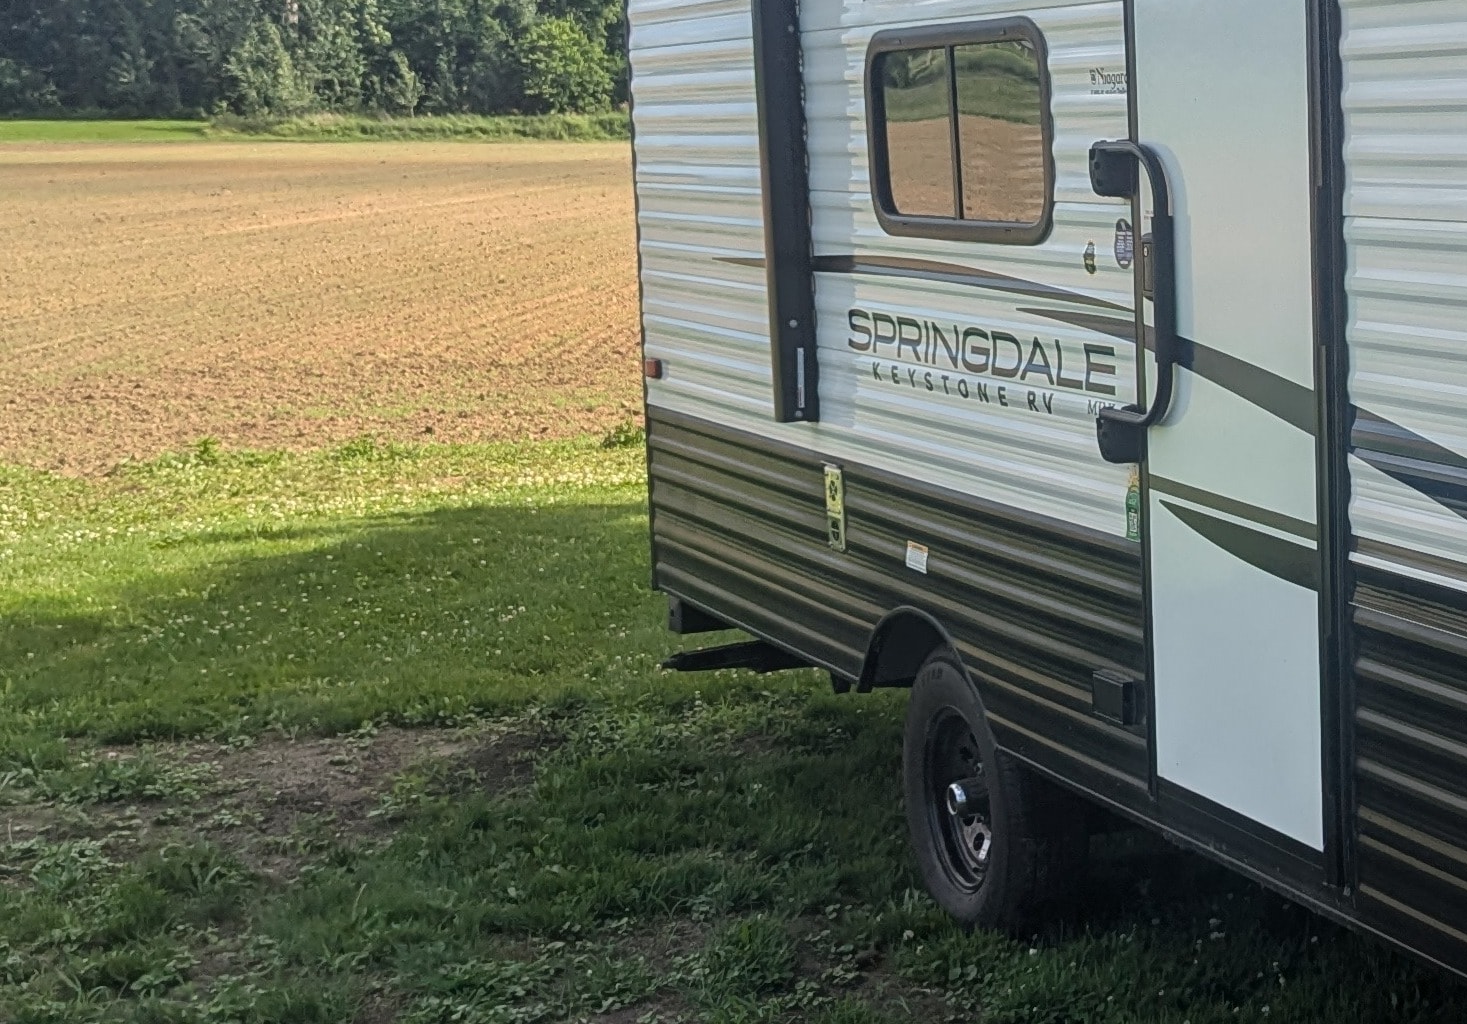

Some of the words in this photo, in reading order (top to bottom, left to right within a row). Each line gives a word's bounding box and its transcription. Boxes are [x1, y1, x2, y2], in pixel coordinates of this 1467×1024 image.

[848, 309, 1116, 396] SPRINGDALE
[872, 361, 1008, 408] KEYSTONE
[1027, 388, 1055, 415] RV
